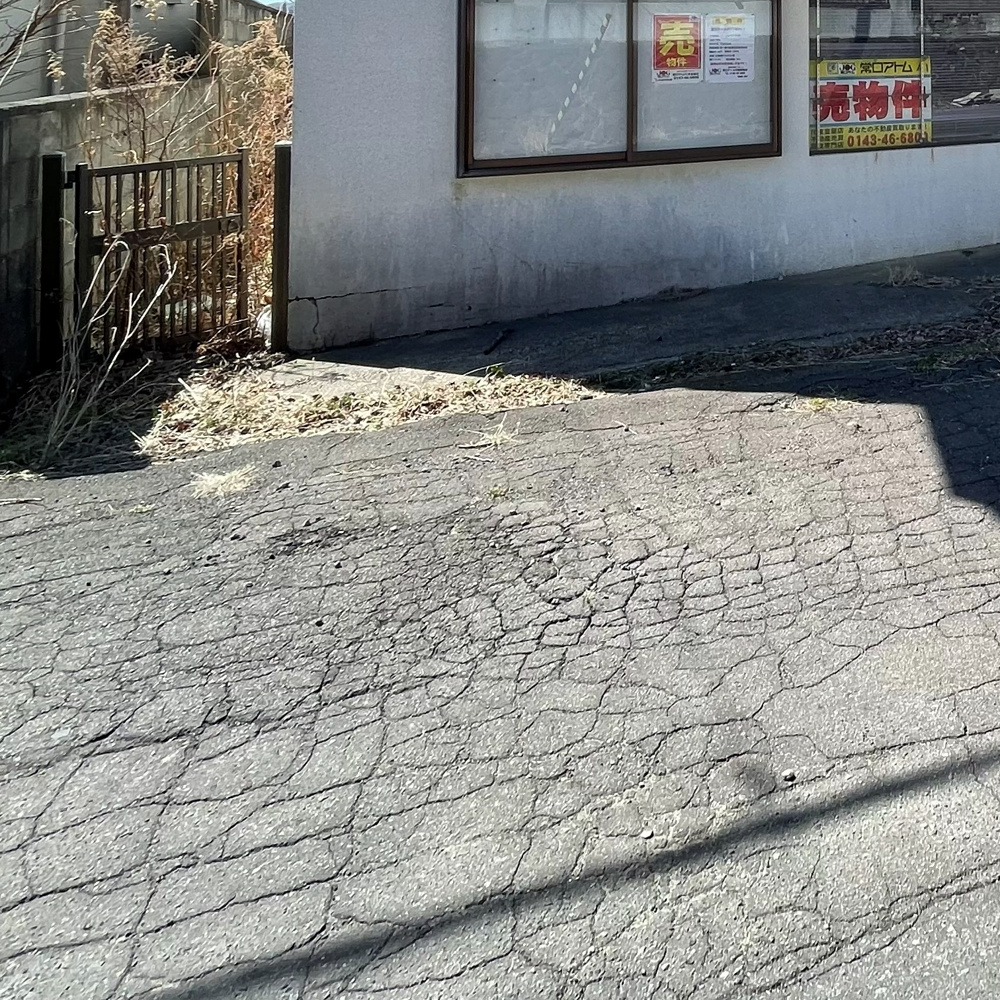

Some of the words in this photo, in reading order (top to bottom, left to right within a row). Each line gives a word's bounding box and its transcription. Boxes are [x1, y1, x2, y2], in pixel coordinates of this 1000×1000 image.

[658, 20, 694, 56] 売
[666, 56, 688, 67] 物件
[860, 61, 912, 74] 常口アトム
[812, 80, 930, 122] 売物件
